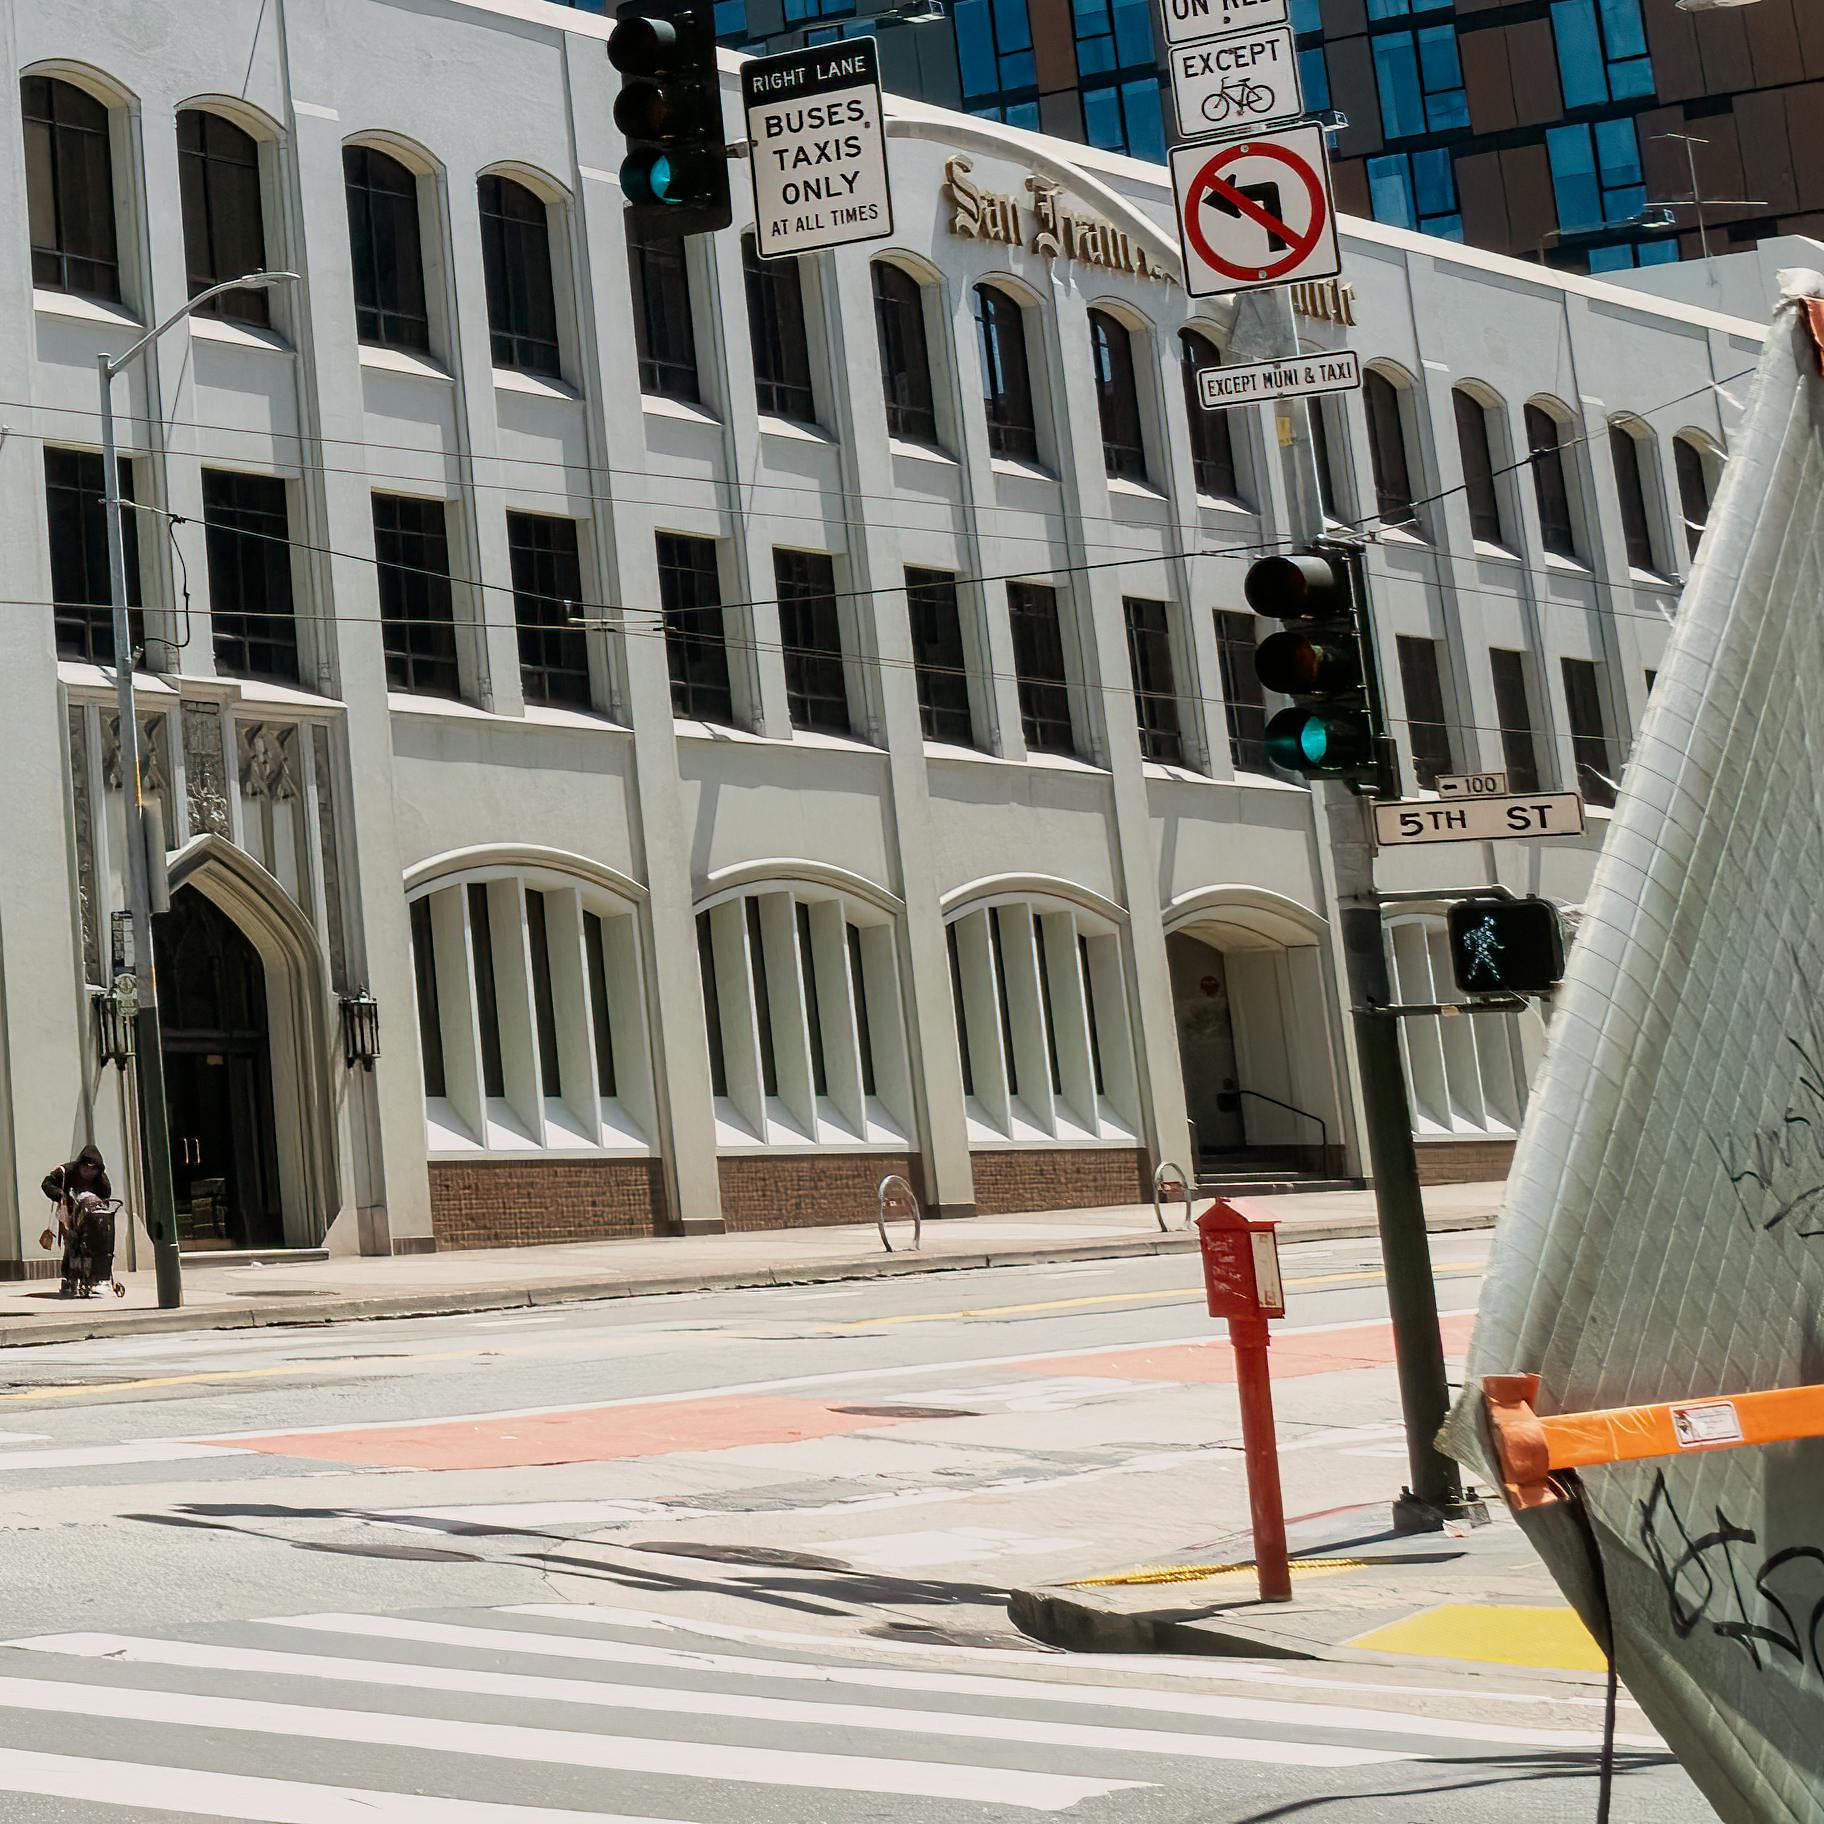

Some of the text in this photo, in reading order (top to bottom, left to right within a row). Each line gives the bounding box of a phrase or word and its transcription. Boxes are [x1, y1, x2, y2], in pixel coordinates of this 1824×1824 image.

[753, 56, 867, 93] RIGHT LANE
[1182, 38, 1282, 78] EXCEPT
[764, 99, 865, 139] BUSES
[772, 135, 862, 172] TAXIS
[782, 170, 860, 205] ONLY
[943, 154, 1024, 246] San
[771, 203, 879, 237] AT ALL TIMES
[1207, 361, 1352, 397] EXCEPT MUNI & TAXI
[1465, 777, 1497, 794] 100
[1399, 804, 1553, 837] 5TH ST
